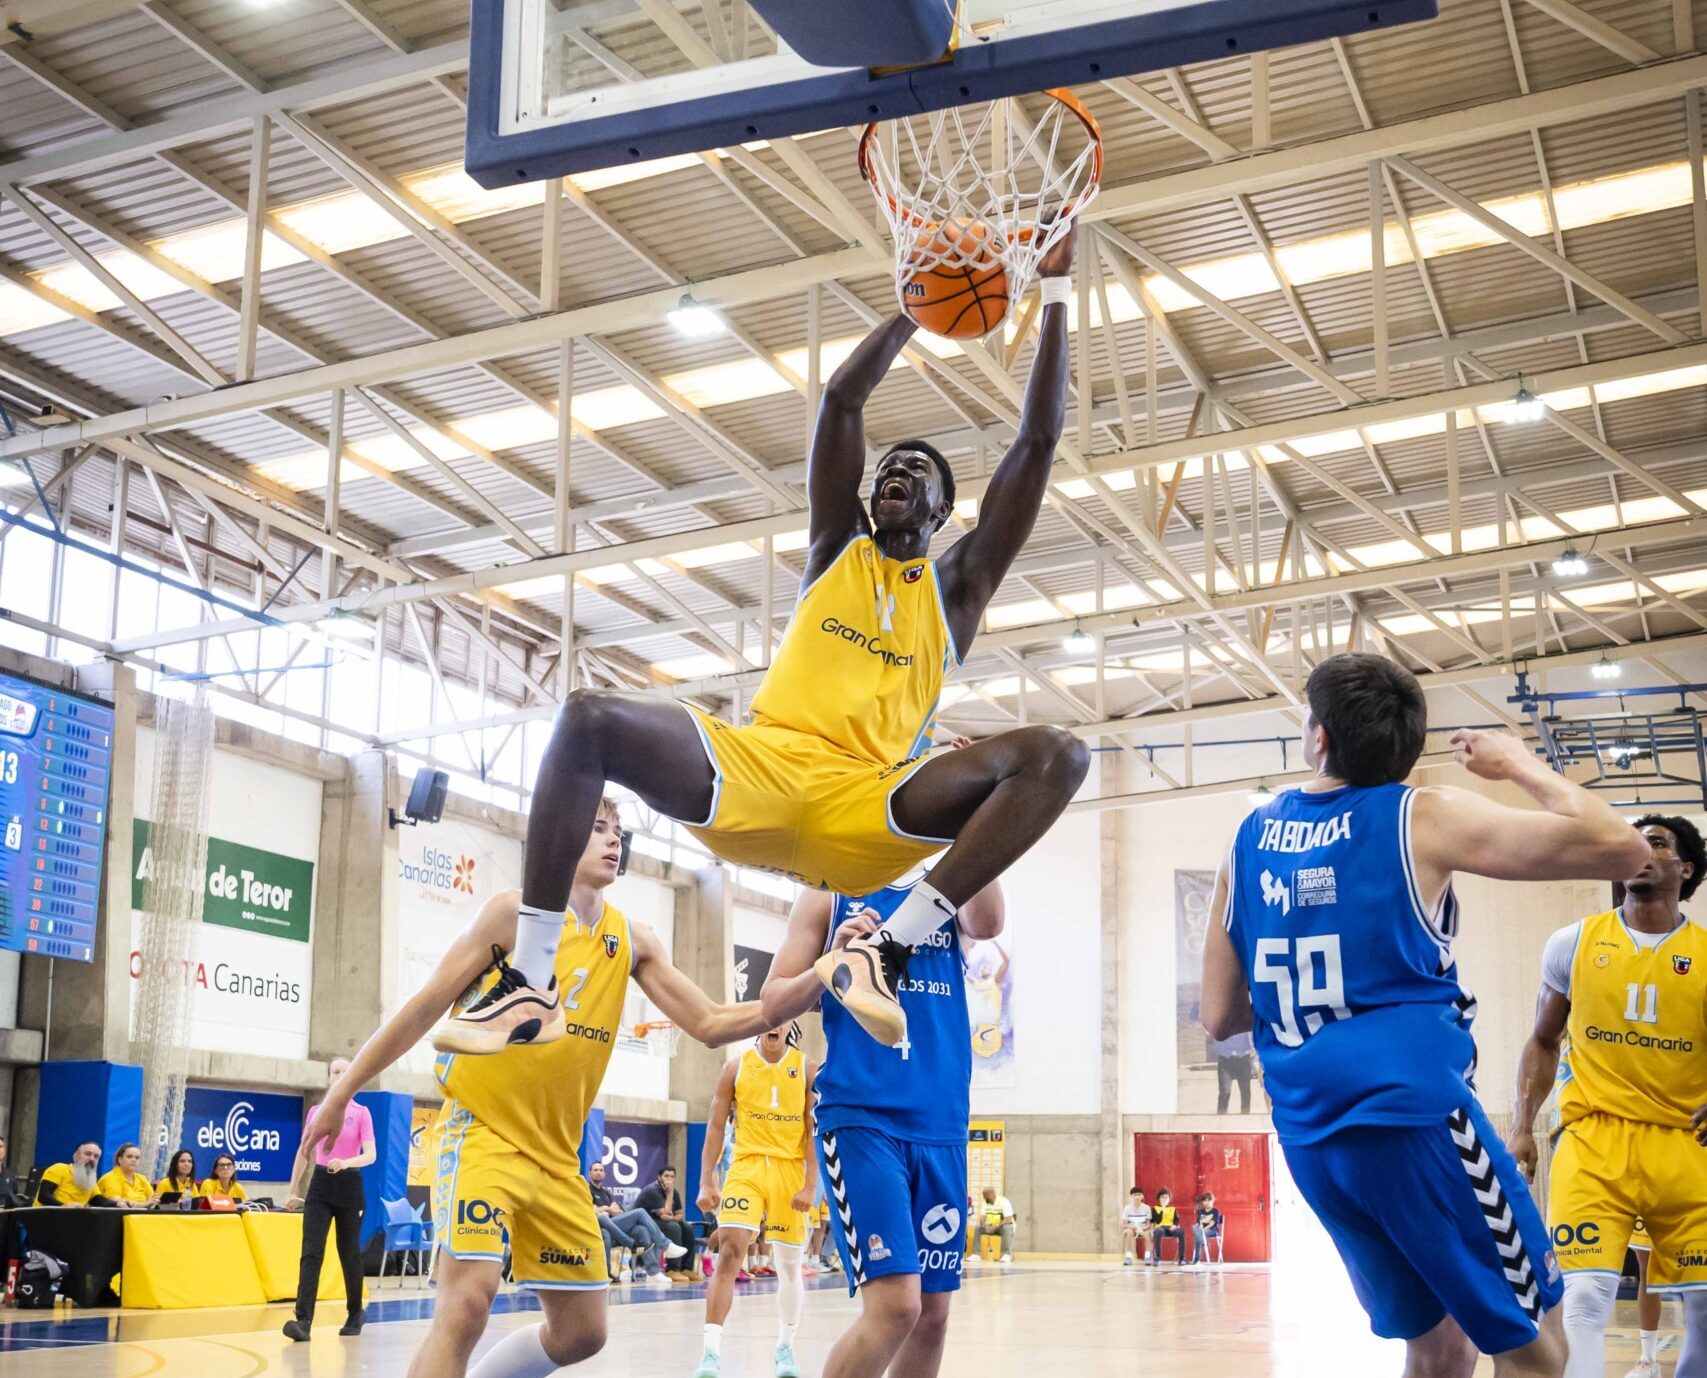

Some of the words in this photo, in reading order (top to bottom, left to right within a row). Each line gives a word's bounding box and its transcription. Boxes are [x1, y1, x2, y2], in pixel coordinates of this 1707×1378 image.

[821, 617, 867, 648] Gran
[9, 826, 18, 846] 3
[423, 845, 453, 871] Islas
[1297, 866, 1335, 879] SEGURA
[208, 864, 239, 900] de
[241, 869, 293, 912] Teror
[214, 963, 300, 1003] Canarias
[564, 966, 588, 1010] 2
[927, 981, 952, 996] 2031
[1254, 934, 1353, 1048] 59
[1623, 982, 1658, 1024] 11
[566, 1022, 611, 1043] anaria
[1585, 1026, 1623, 1044] Gran
[1625, 1031, 1693, 1053] Canaria
[770, 1084, 780, 1108] 1
[766, 1112, 802, 1122] Canaria
[539, 1252, 586, 1266] SUMA
[1573, 1246, 1603, 1256] Dental
